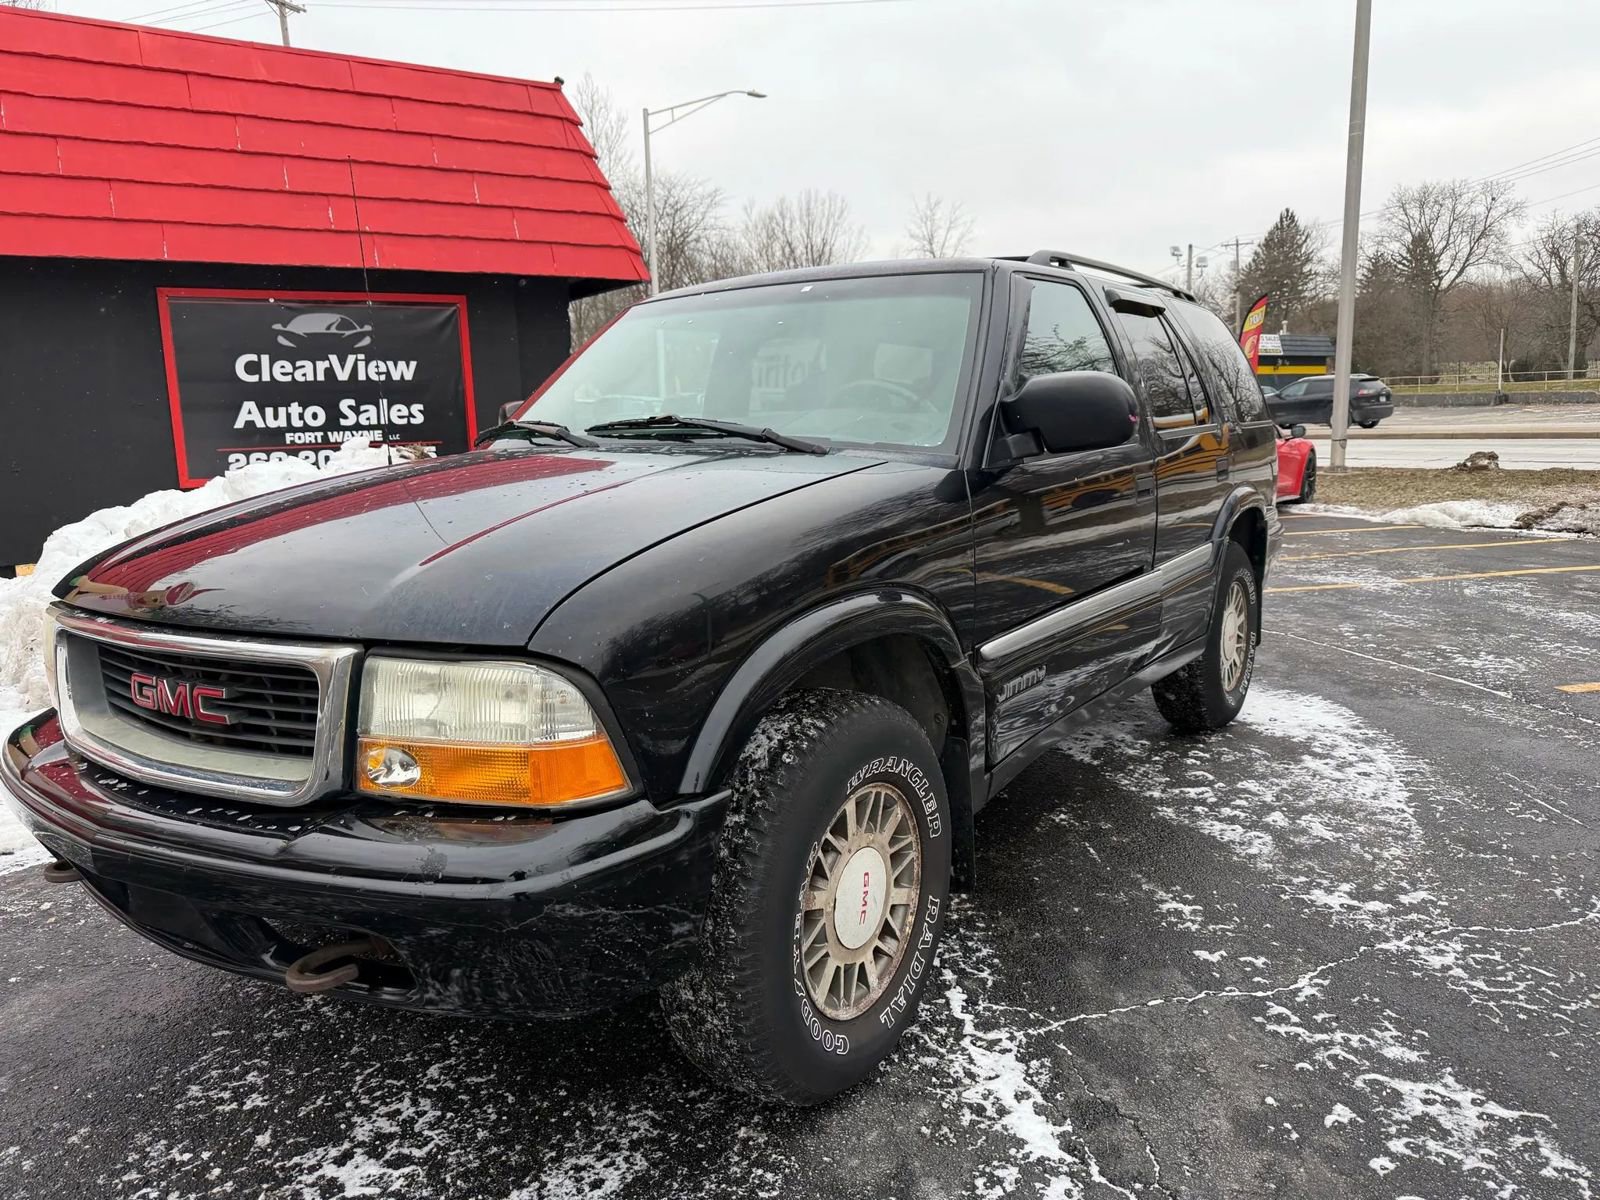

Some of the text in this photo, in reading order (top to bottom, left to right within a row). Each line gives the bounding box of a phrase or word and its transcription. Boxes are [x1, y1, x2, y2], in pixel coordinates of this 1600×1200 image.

[234, 354, 417, 382] ClearView
[233, 398, 425, 429] Auto Sales
[285, 431, 325, 444] FORT
[327, 430, 383, 443] WAYNE
[130, 672, 230, 725] GMC
[846, 756, 942, 838] WRANGLER
[858, 871, 870, 925] GMC
[880, 895, 940, 1029] RADIAL
